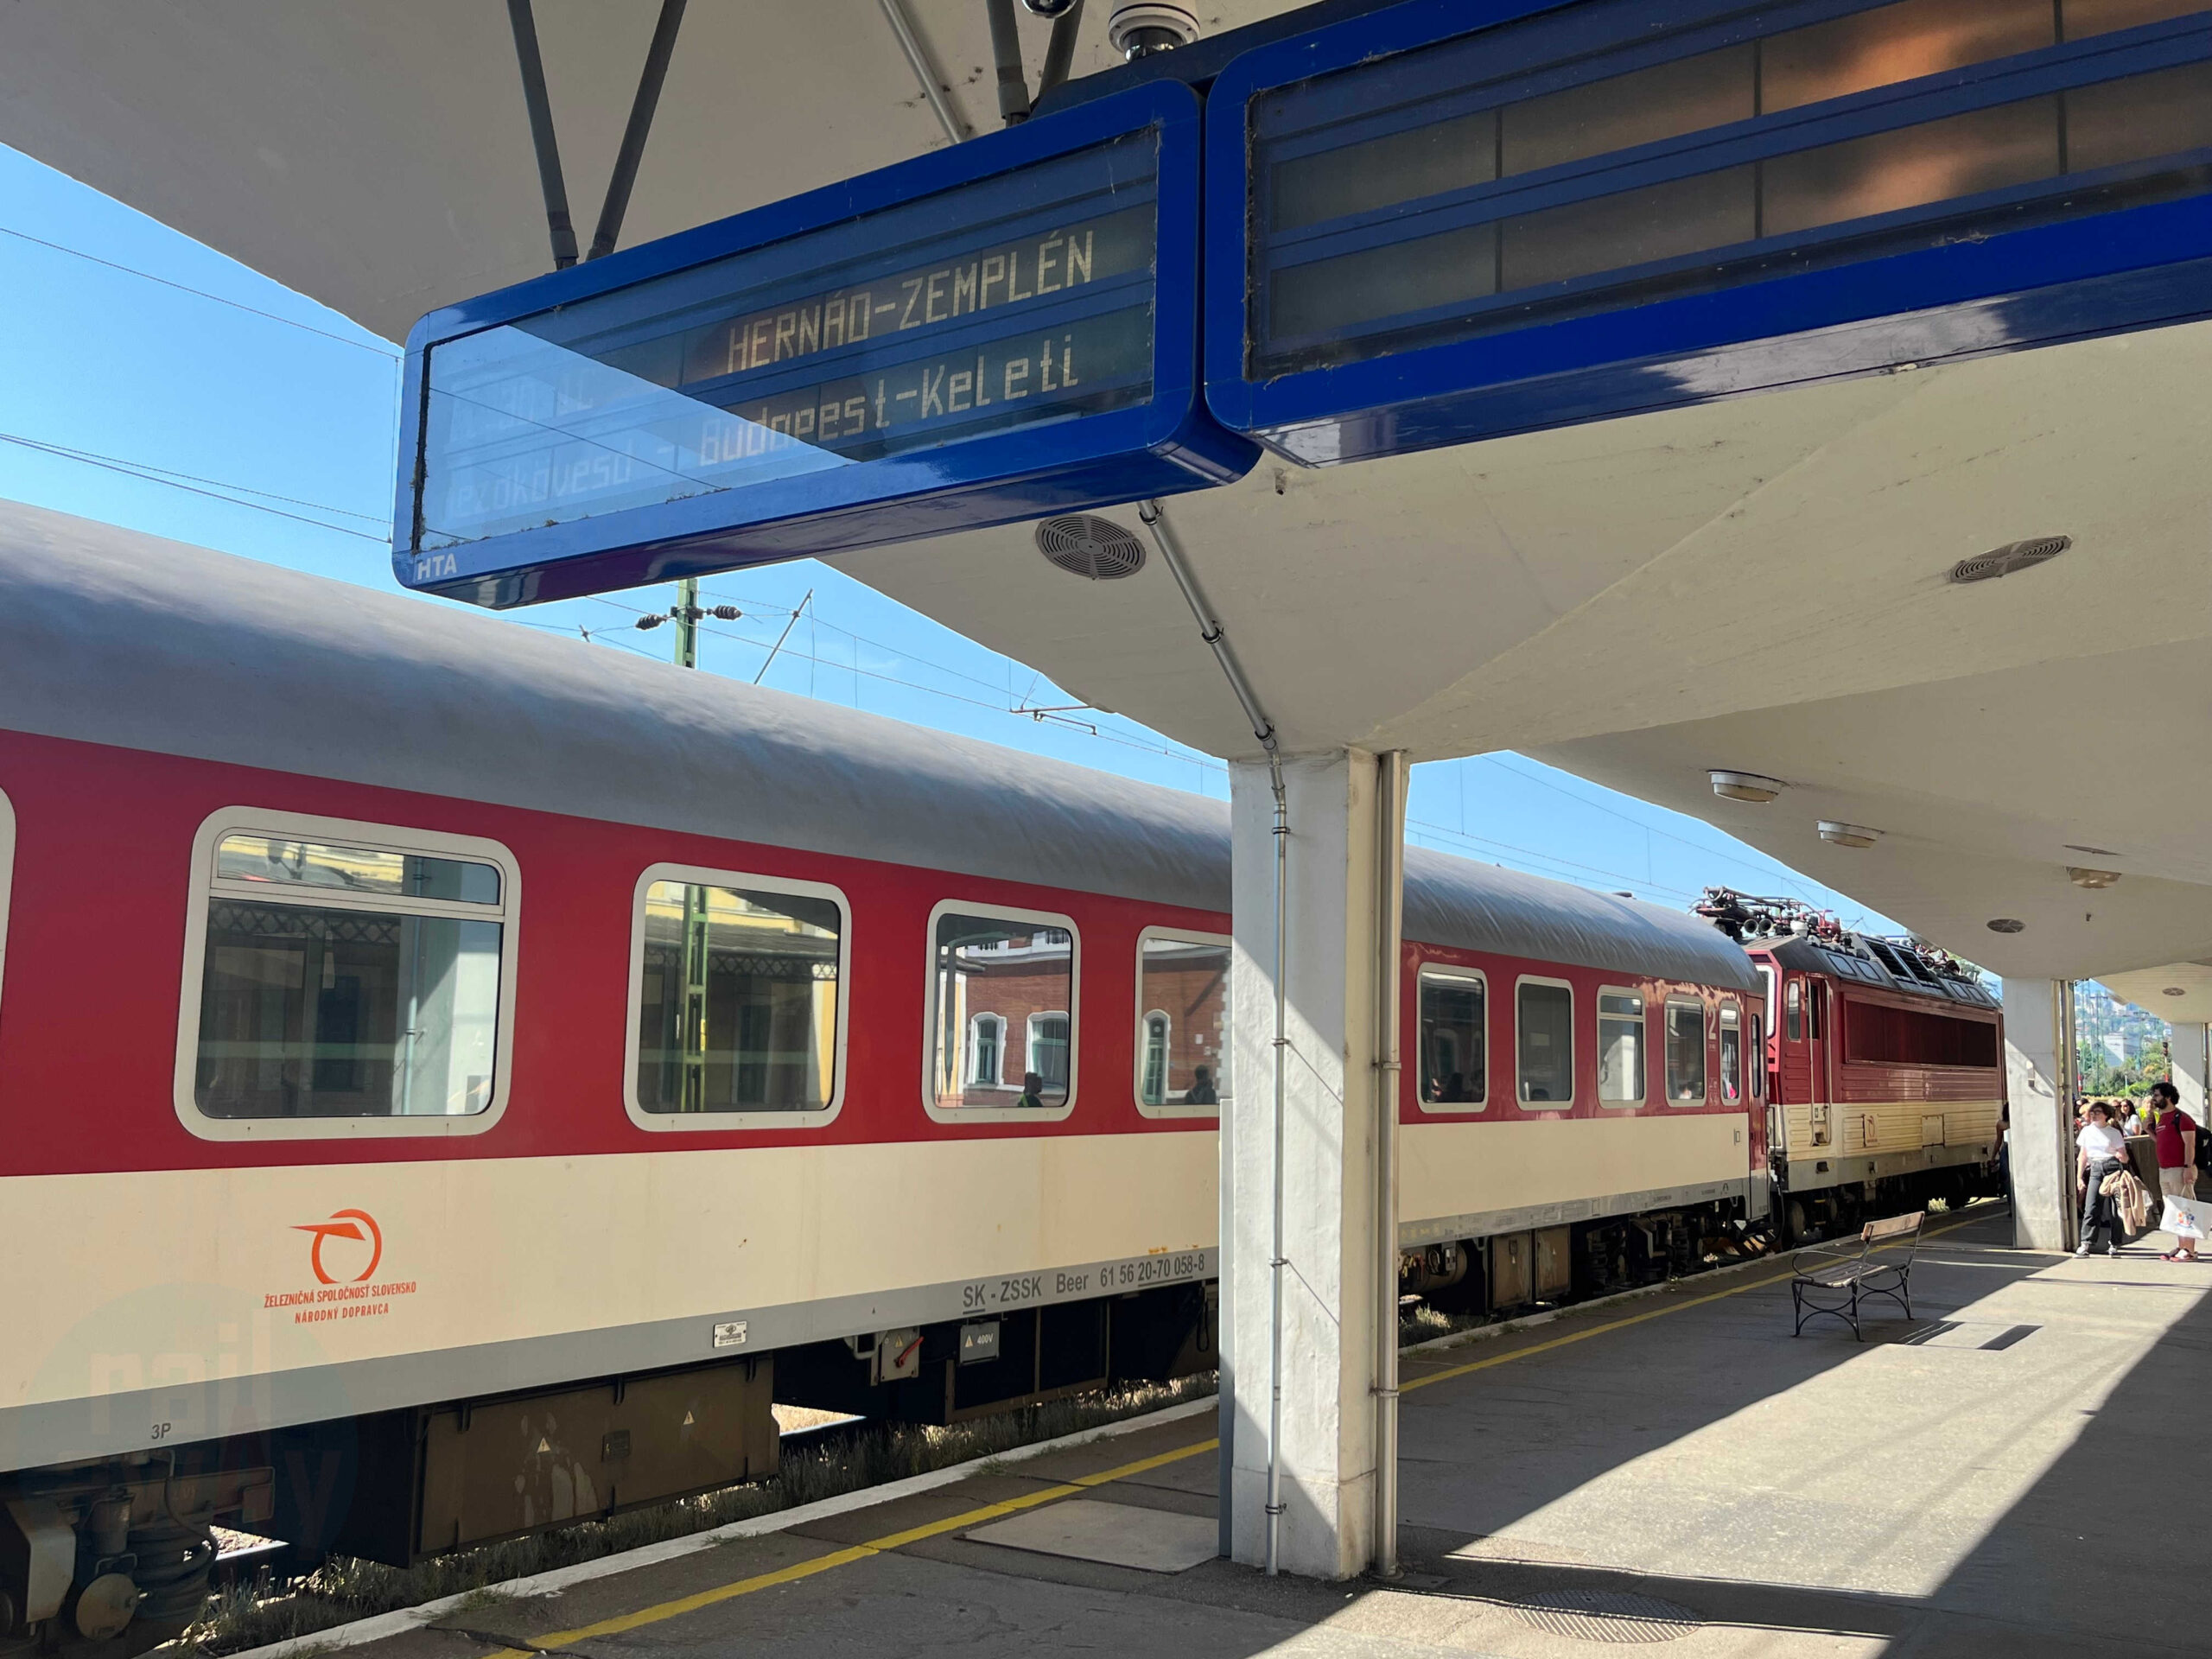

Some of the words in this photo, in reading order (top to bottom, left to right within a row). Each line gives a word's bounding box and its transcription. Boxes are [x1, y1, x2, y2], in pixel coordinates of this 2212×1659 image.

[728, 230, 1093, 374] HERNÁD-ZEMPLÉN
[417, 553, 457, 580] HTA
[1707, 1005, 1717, 1039] 2
[264, 1290, 315, 1308] ŽELEZNIČNÁ
[317, 1286, 370, 1302] SPOLOČNOSŤ
[372, 1281, 416, 1297] SLOVENSKO
[963, 1283, 986, 1308] SK
[1000, 1276, 1042, 1303] ZSSK
[1056, 1273, 1089, 1294] Beer
[1100, 1266, 1115, 1287] 61
[1119, 1264, 1135, 1284] 56
[1137, 1258, 1171, 1281] 20-70
[1173, 1254, 1205, 1275] 058-8
[295, 1306, 339, 1325] NÁRODNÝ
[342, 1303, 389, 1319] DOPRAVCA
[976, 1333, 994, 1344] 400V
[151, 1422, 172, 1440] 3P
